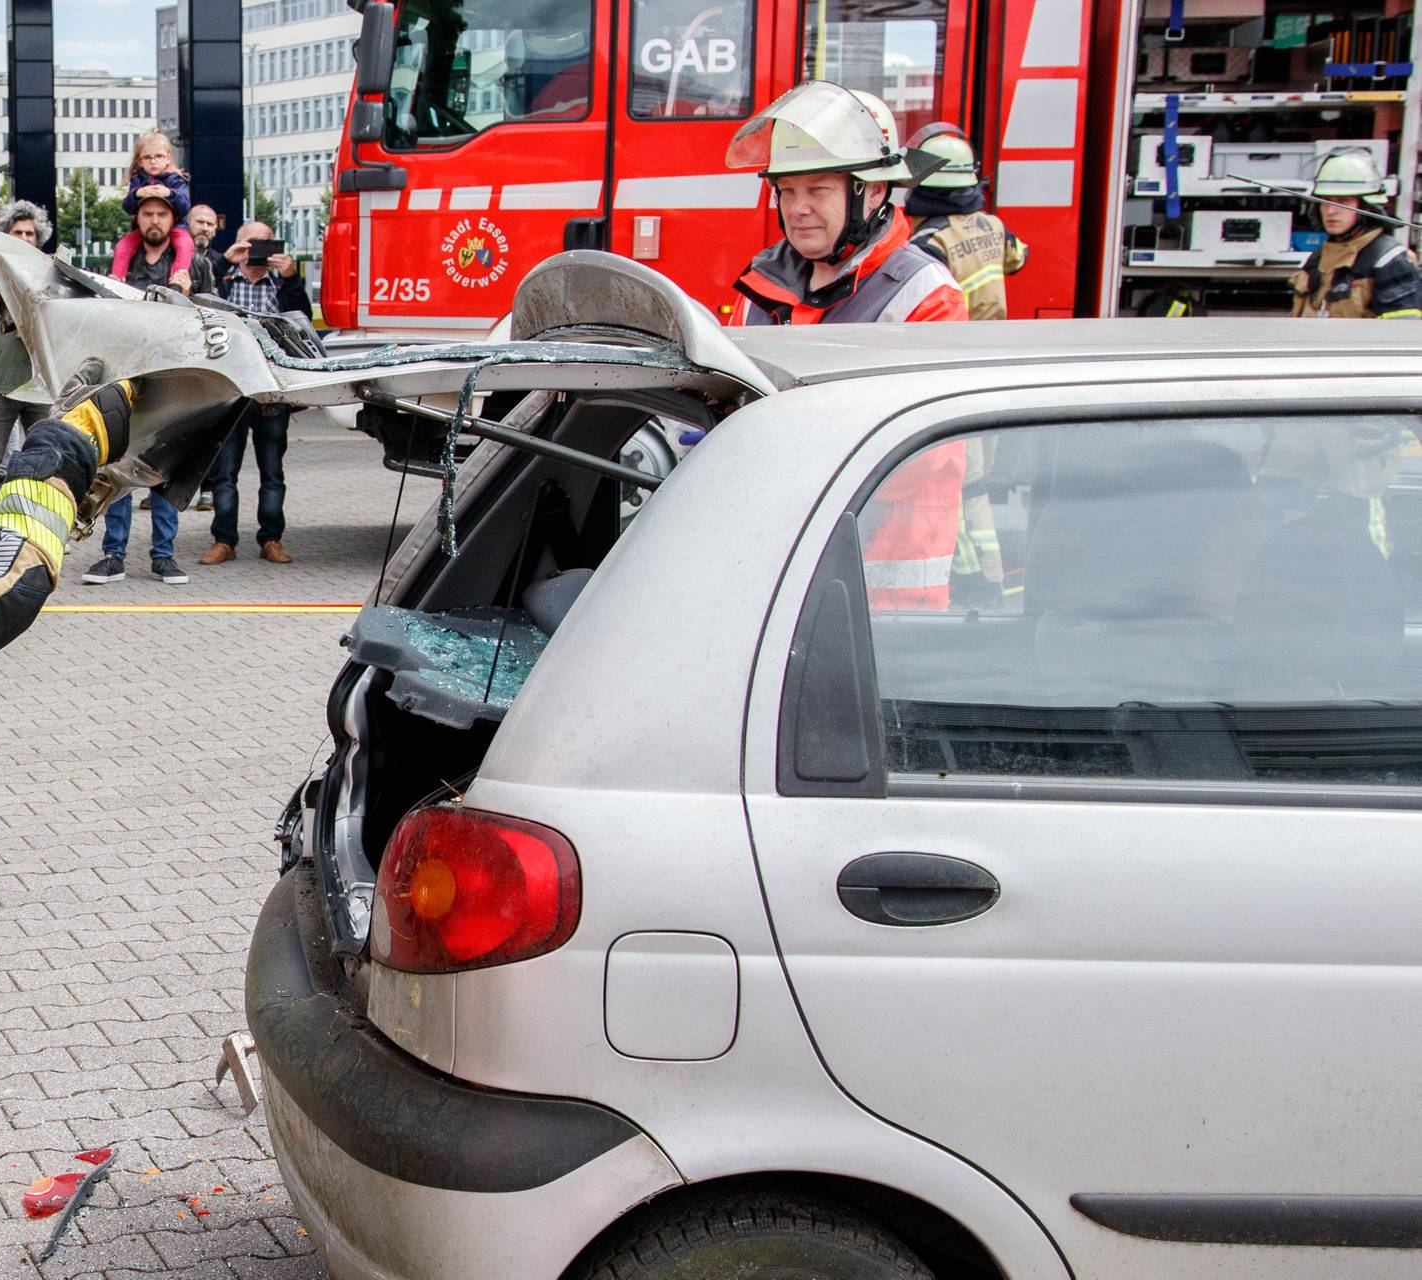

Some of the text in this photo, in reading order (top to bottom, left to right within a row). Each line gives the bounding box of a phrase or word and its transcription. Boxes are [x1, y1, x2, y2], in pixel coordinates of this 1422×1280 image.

[640, 38, 737, 74] GAB
[441, 217, 510, 253] Stadt Essen
[949, 231, 1003, 261] FEUERWE
[442, 258, 509, 289] Feuerwehr
[373, 277, 431, 302] 2/35
